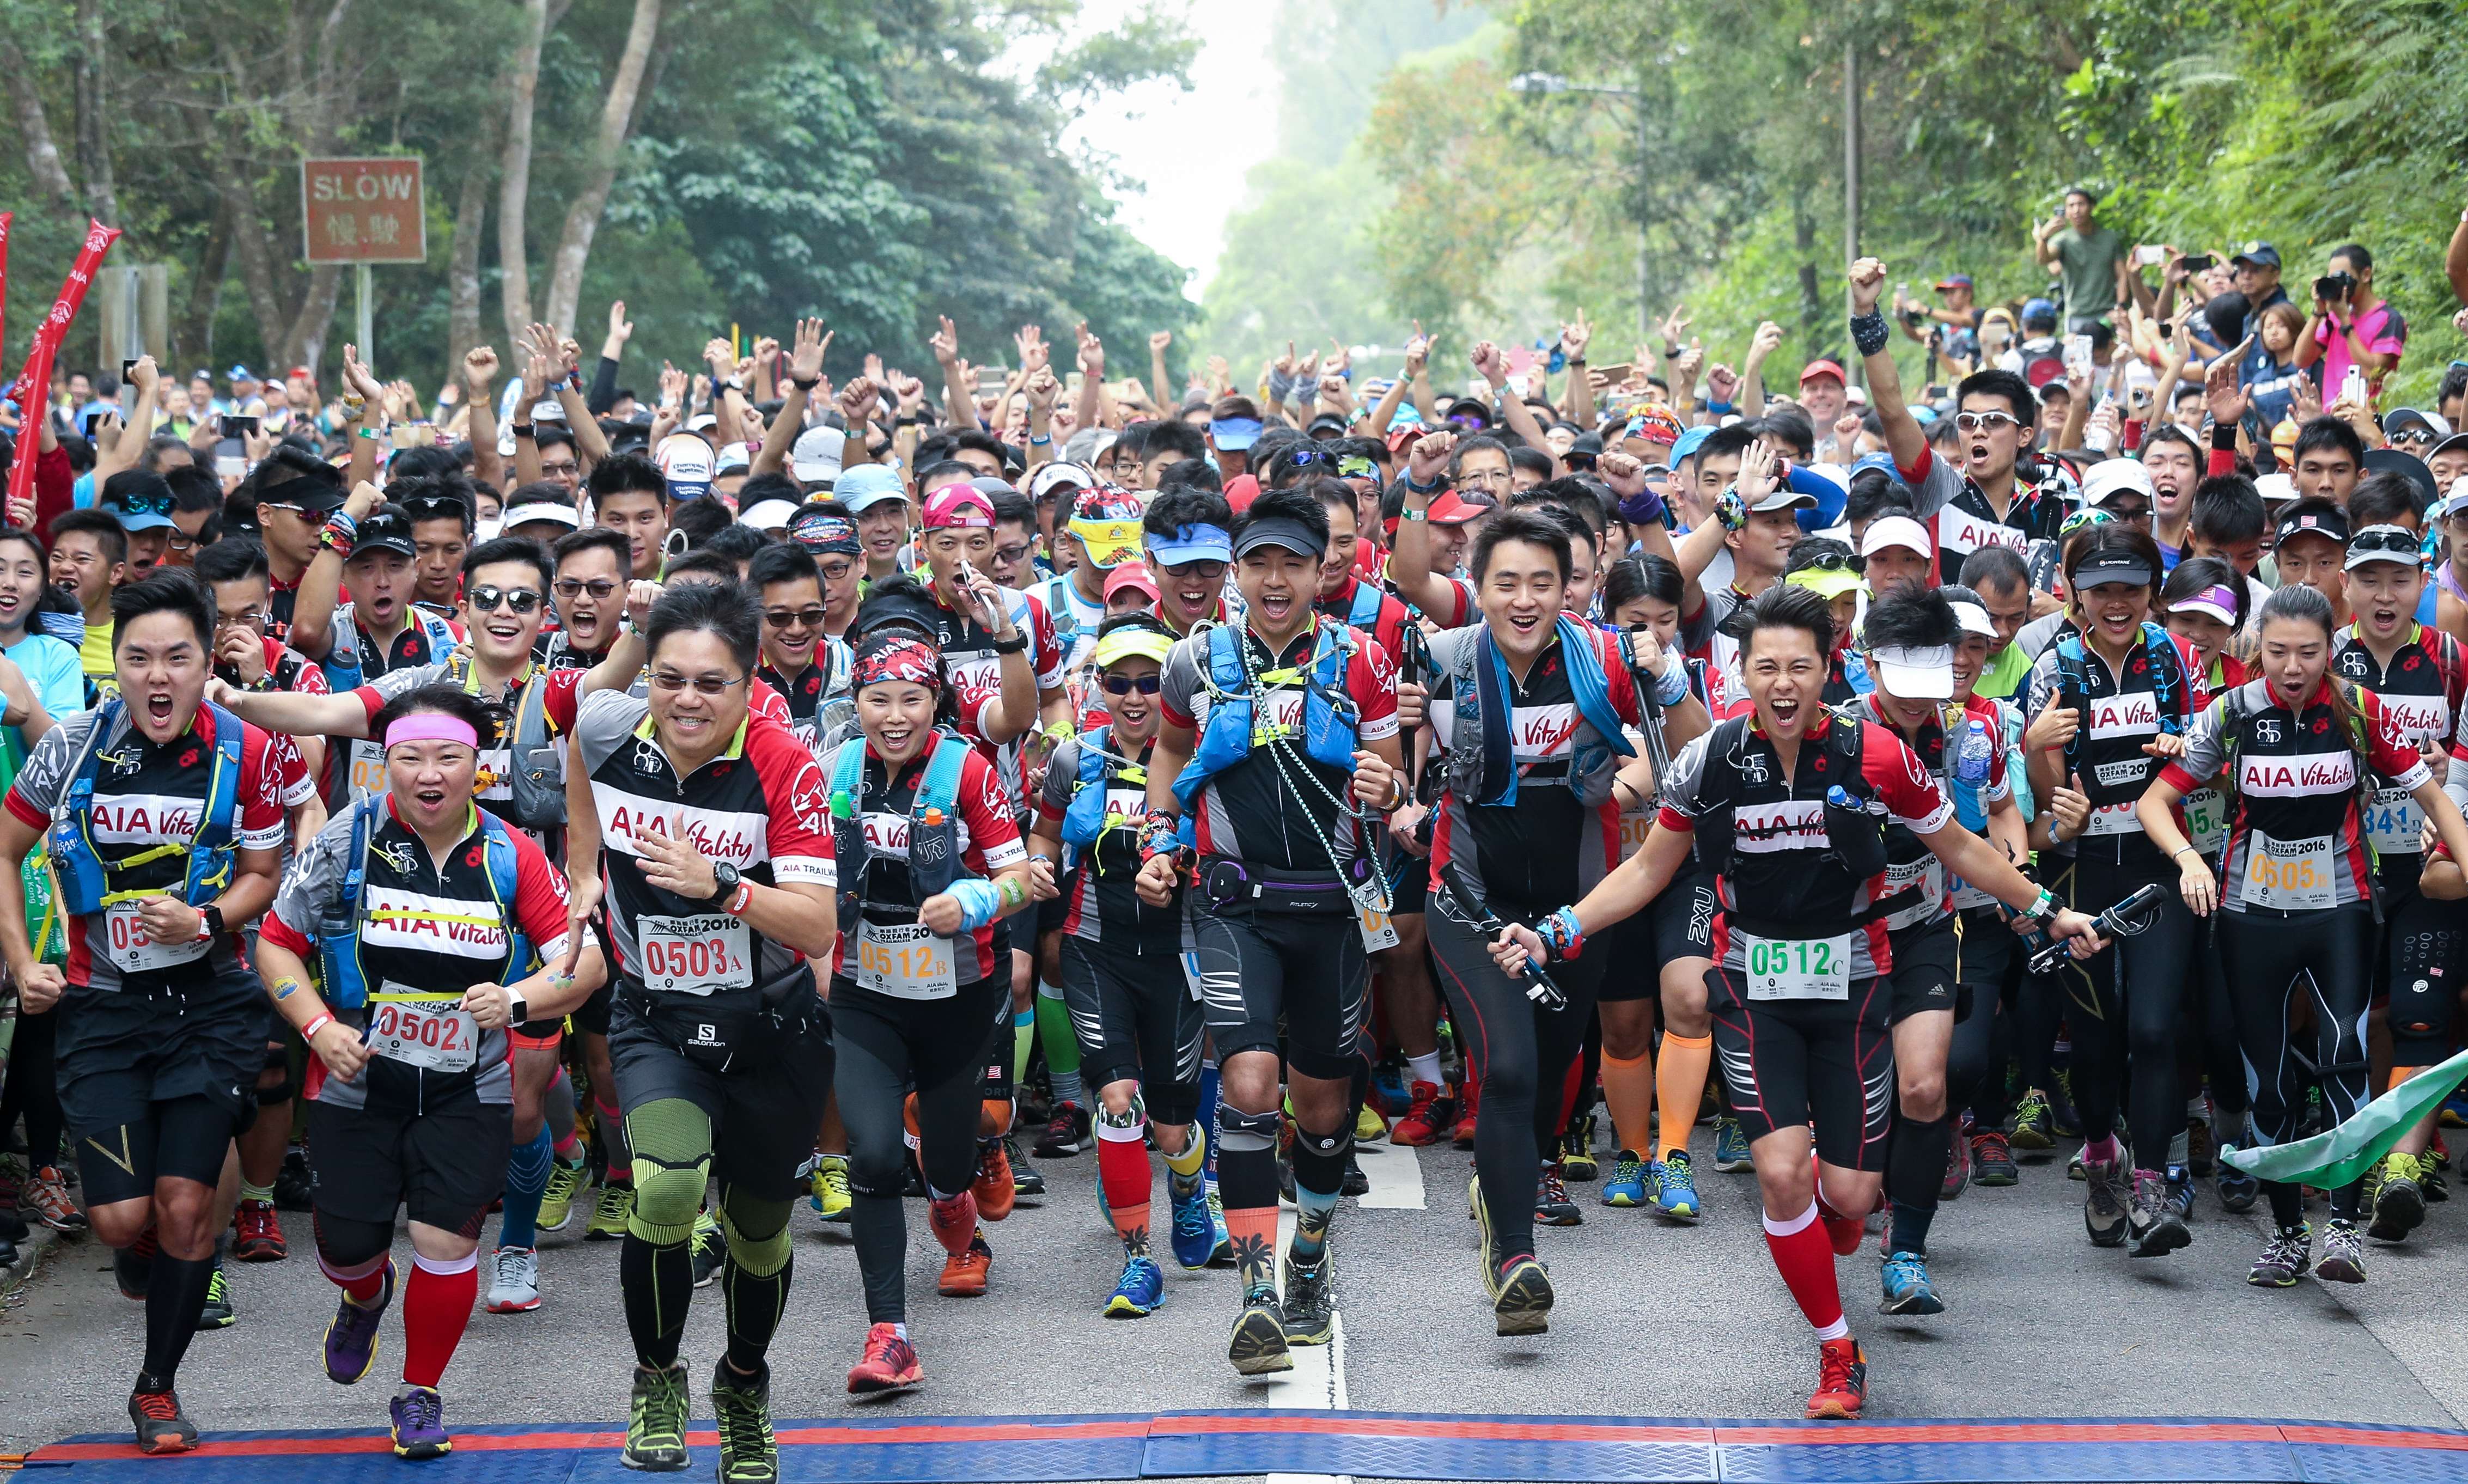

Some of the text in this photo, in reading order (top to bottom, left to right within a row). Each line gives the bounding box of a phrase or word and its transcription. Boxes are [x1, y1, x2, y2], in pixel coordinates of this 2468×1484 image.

[314, 174, 412, 200] SLOW
[70, 270, 88, 285] AIA
[386, 536, 408, 546] 2XU
[1959, 525, 2028, 555] AIA Vita
[954, 665, 1002, 688] A Vita
[1279, 699, 1303, 726] Vit
[2091, 701, 2157, 729] IA Vital
[1371, 725, 1385, 733] AIA
[2393, 732, 2413, 750] AI
[284, 745, 302, 763] AI
[354, 761, 385, 791] 03
[2100, 764, 2146, 778] OXFAM 20
[2246, 762, 2351, 788] AIA Vitality
[262, 783, 284, 807] AI
[288, 791, 300, 799] AIA
[2189, 792, 2218, 804] 2016
[1107, 799, 1123, 815] A
[93, 806, 195, 835] AIA Vita
[611, 807, 667, 846] AIA
[1736, 815, 1792, 841] AIA
[1927, 816, 1940, 827] AIA
[864, 823, 909, 848] A Vit
[2271, 840, 2326, 856] OXFAM 2016
[1914, 855, 1936, 873] 2016
[372, 903, 440, 937] AIA
[701, 917, 740, 933] 2016
[1687, 886, 1715, 946] 2XU
[112, 917, 150, 950] 05
[879, 926, 930, 941] OXFAM 20
